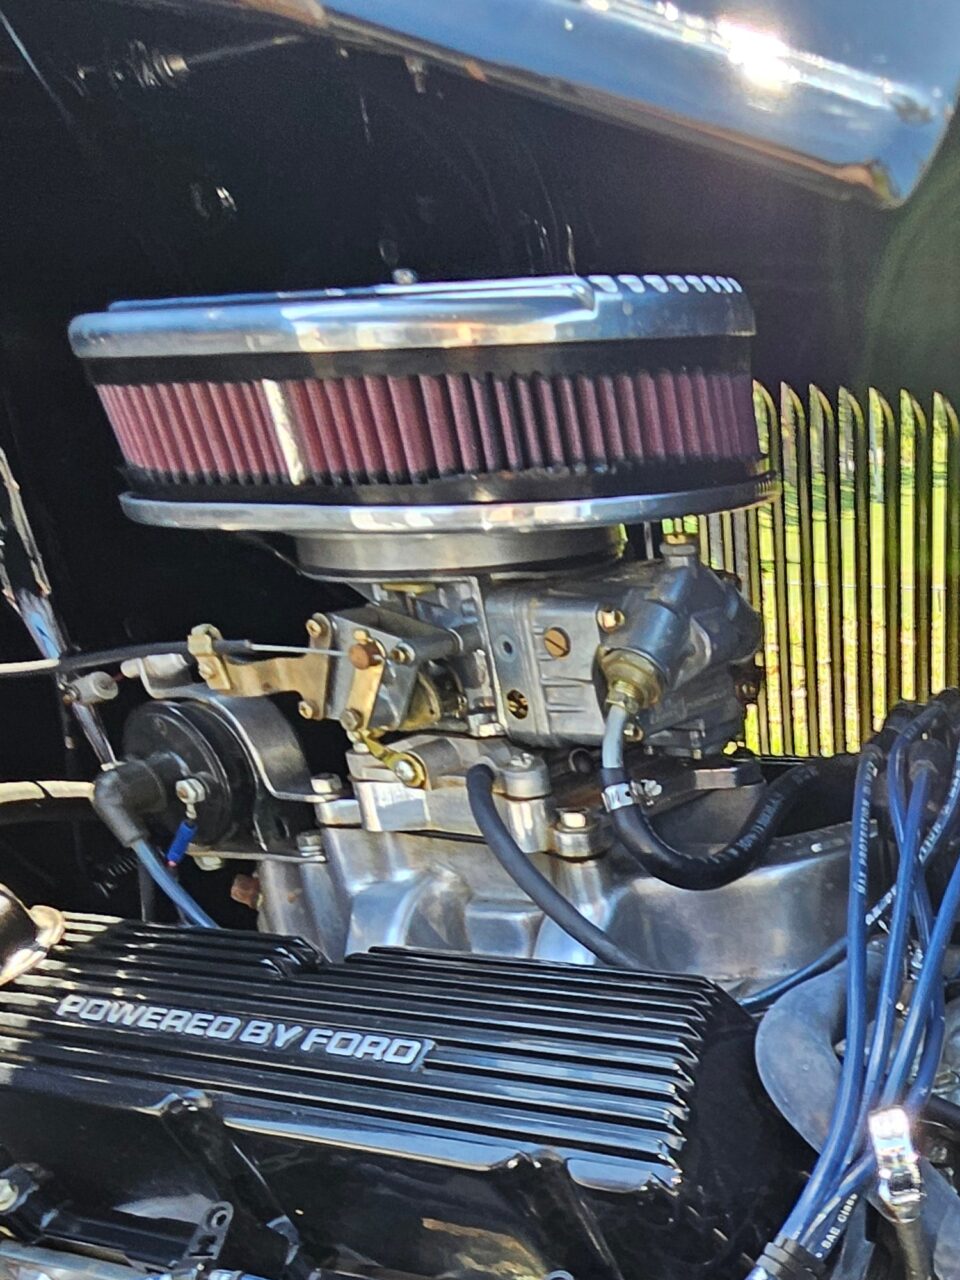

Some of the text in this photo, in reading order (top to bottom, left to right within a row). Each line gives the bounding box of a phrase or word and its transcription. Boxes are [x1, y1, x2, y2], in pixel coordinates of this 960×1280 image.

[857, 798, 871, 866] PROTECTION
[56, 994, 422, 1064] POWERED BY FORD
